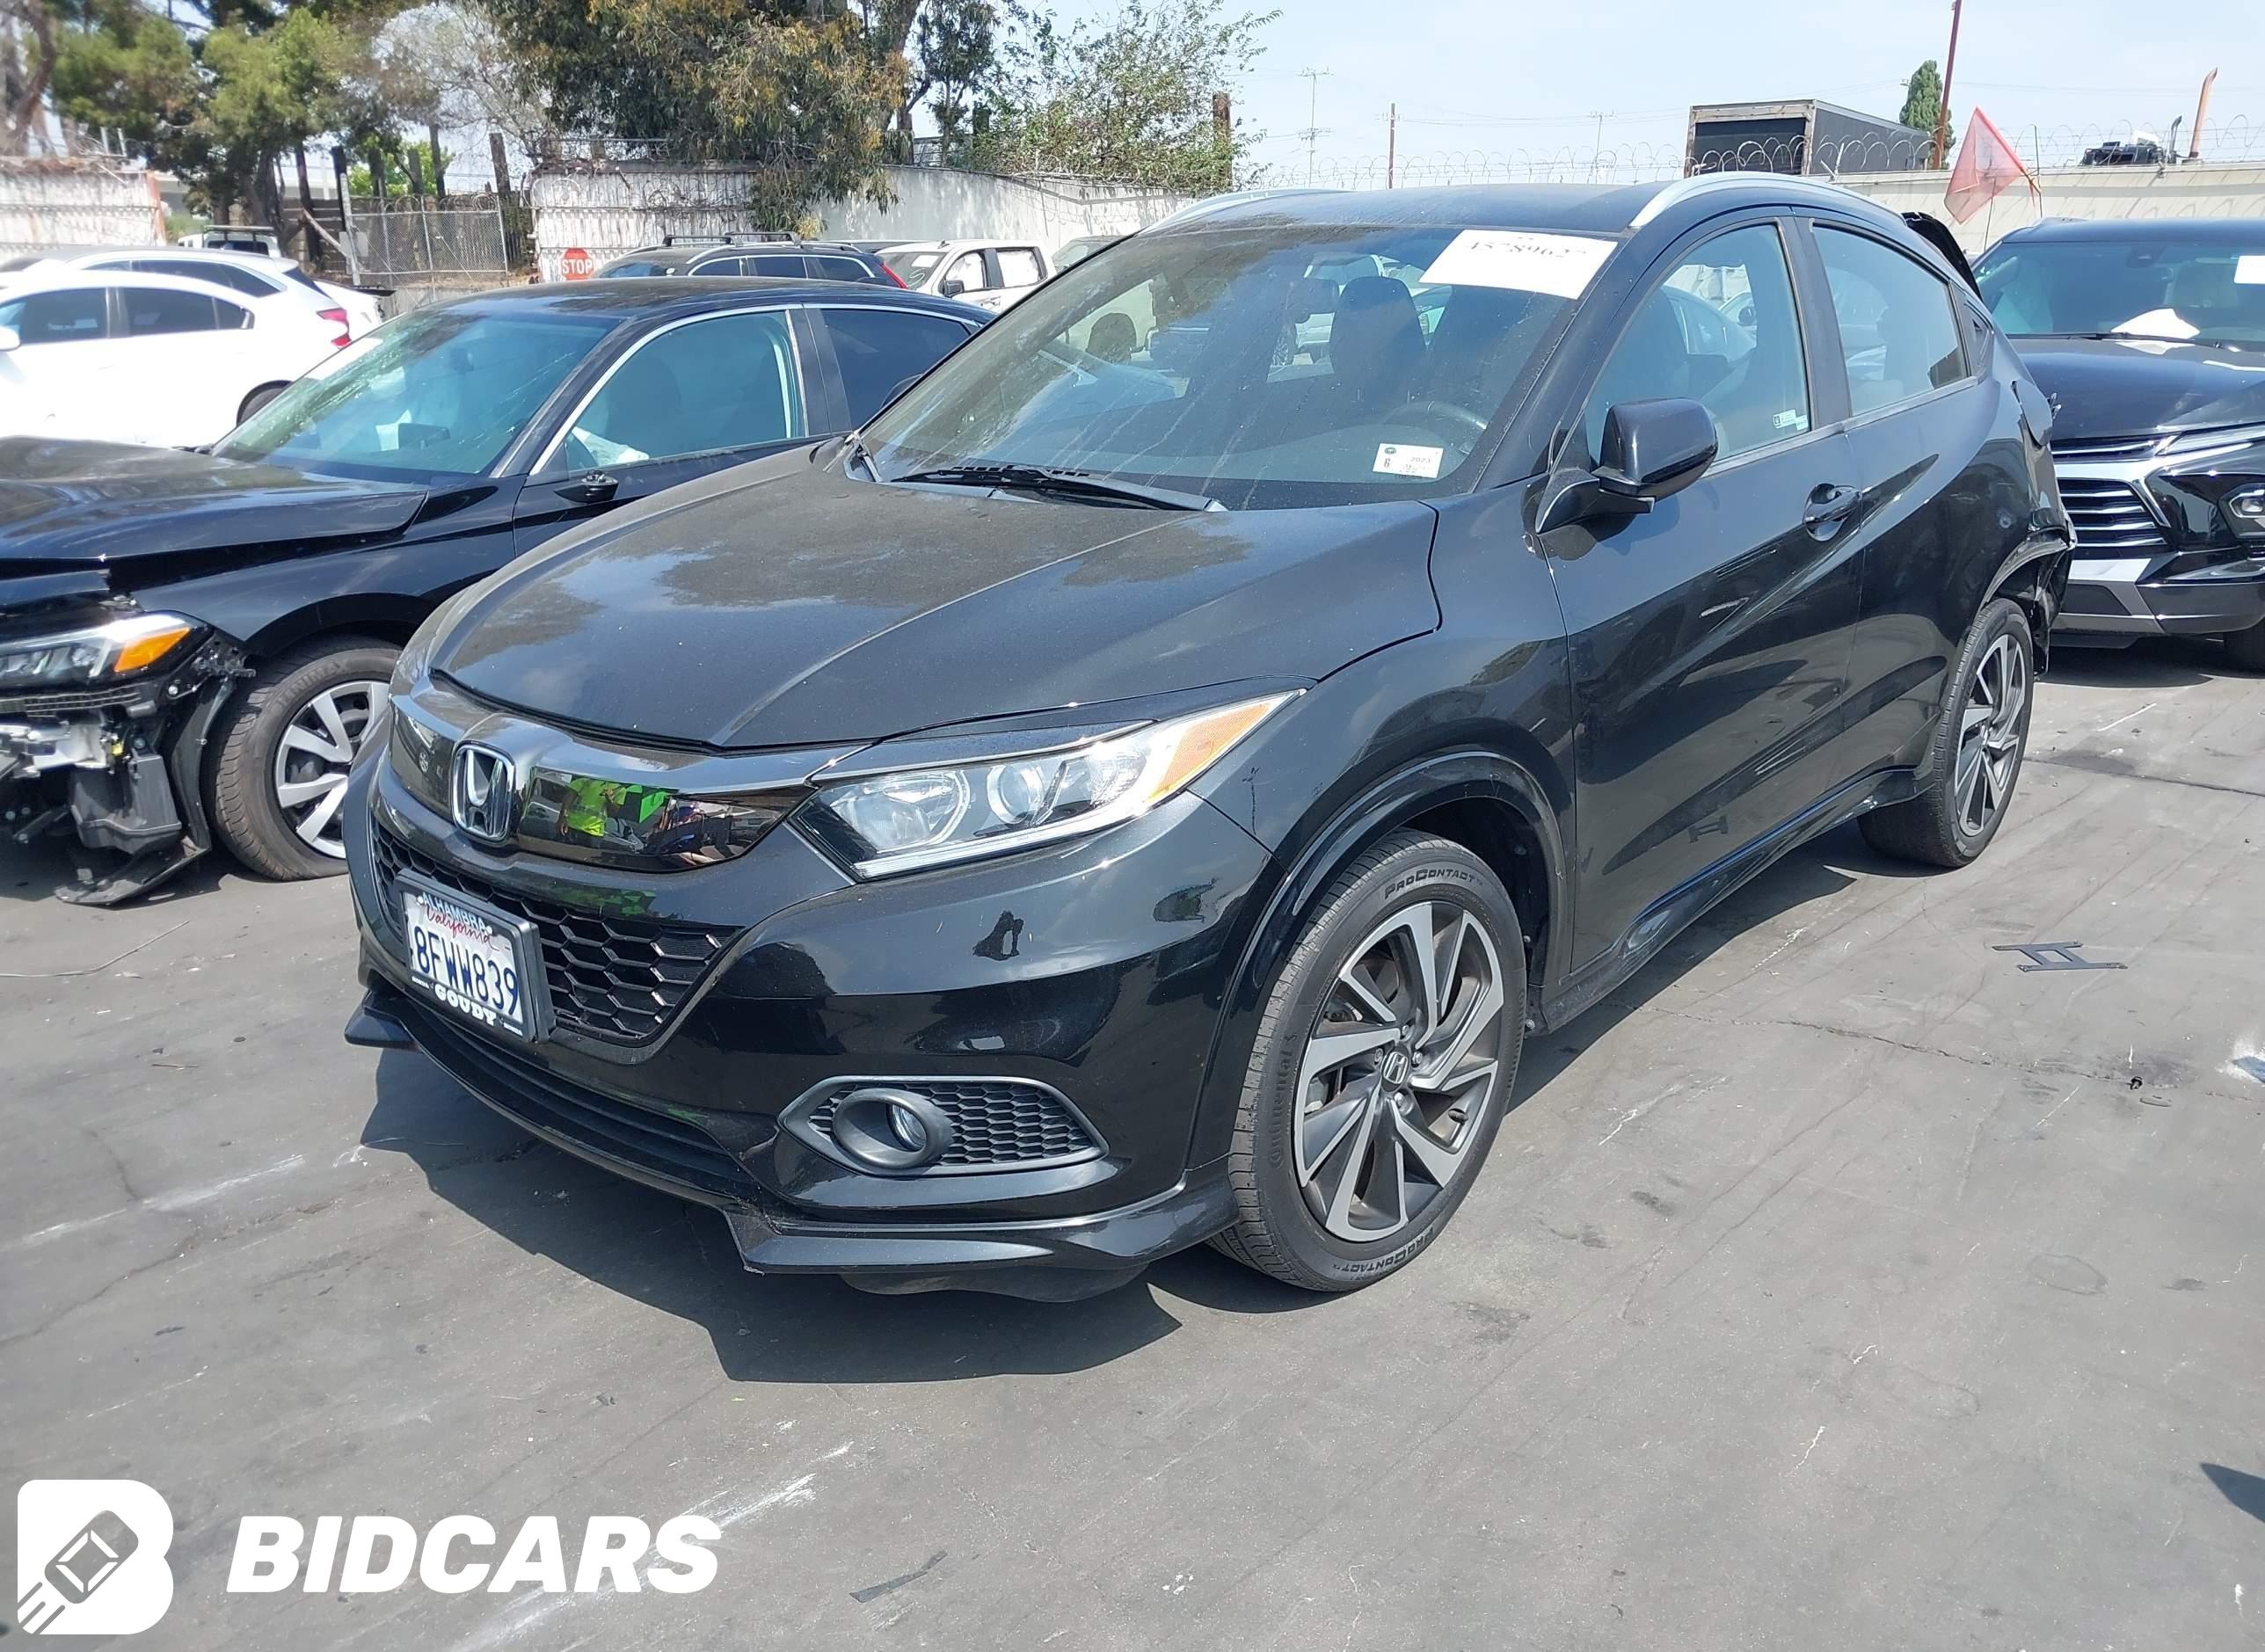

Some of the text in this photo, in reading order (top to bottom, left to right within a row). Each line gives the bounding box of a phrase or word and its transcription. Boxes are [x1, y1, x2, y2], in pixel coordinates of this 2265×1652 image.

[562, 258, 593, 274] STOP
[422, 891, 487, 933] ALHAMBRA
[414, 926, 518, 1015] 8FWW839
